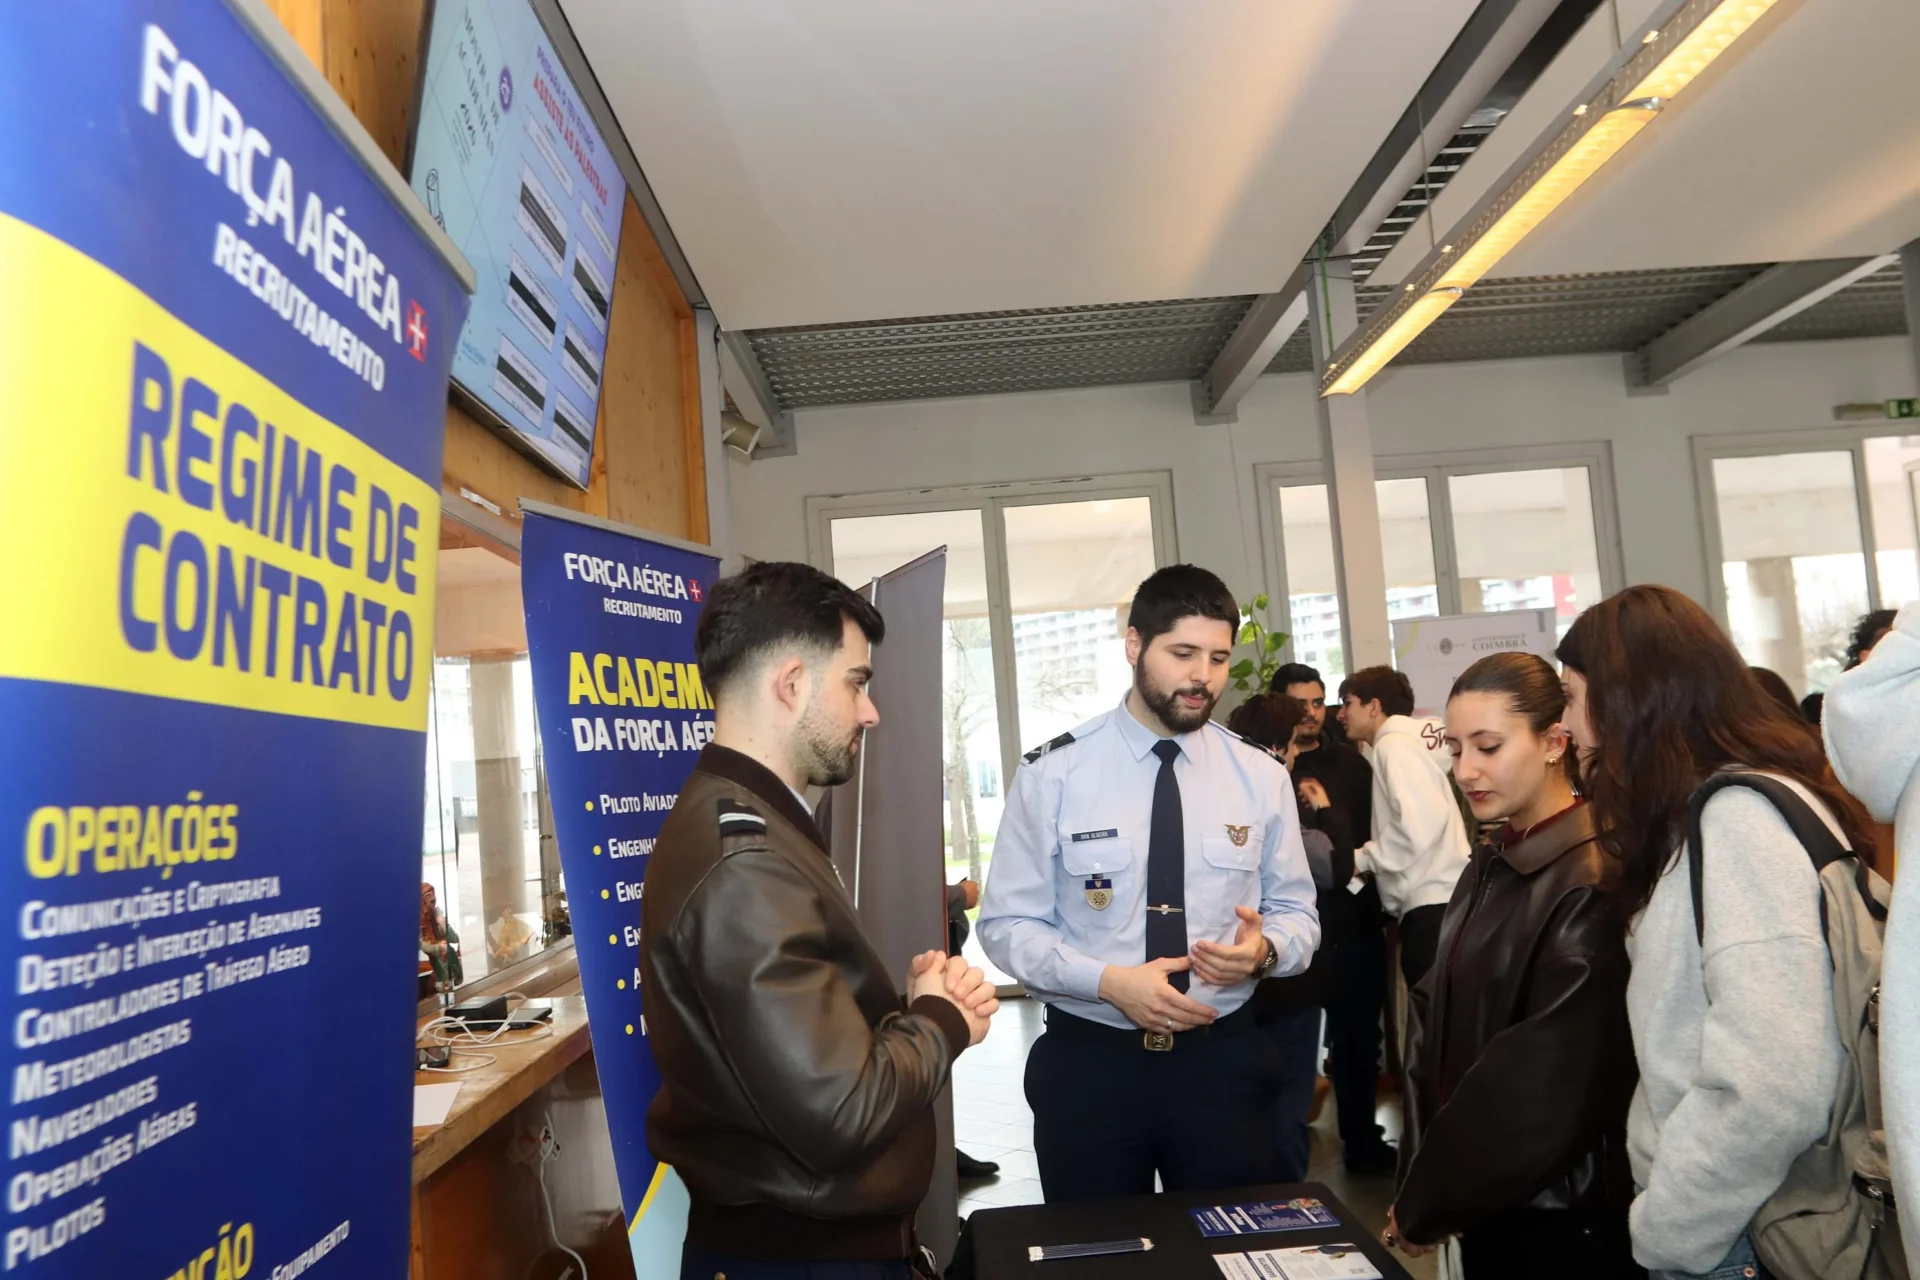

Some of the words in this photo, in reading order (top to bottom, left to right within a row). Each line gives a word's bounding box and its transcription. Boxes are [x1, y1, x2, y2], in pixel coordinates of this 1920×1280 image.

[140, 23, 295, 245] FORÇA
[297, 192, 403, 343] AÉREA
[214, 222, 385, 391] RECRUTAMENTO
[126, 339, 356, 570] REGIME
[366, 483, 419, 595] DE
[119, 511, 413, 702] CONTRATO
[563, 552, 631, 593] FORÇA
[633, 564, 689, 600] AÉREA
[603, 598, 682, 624] RECRUTAMENTO
[568, 652, 715, 710] ACADEM
[571, 717, 613, 752] DA
[614, 718, 678, 758] FORÇA
[25, 791, 238, 878] OPERAÇÕES
[600, 793, 641, 815] PILOTO
[608, 838, 657, 859] ENGENH
[18, 942, 121, 995] DETEÇÃO
[123, 943, 136, 972] E
[136, 920, 226, 969] INTERCEÇÃO
[228, 919, 246, 944] DE
[247, 907, 322, 940] AERONAVES
[21, 887, 171, 940] COMUNICAÇÕES
[174, 889, 186, 914] E
[187, 876, 281, 911] CRIPTOGRAFIA
[15, 977, 180, 1049] CONTROLADORES
[182, 971, 204, 1000] DE
[205, 955, 265, 993] TRÁFEGO
[266, 943, 310, 975] AÉREO
[12, 1018, 191, 1105] METEOROLOGISTAS
[8, 1133, 134, 1214] OPERAÇÕES
[136, 1101, 197, 1154] AÉREAS
[10, 1075, 158, 1160] NAVEGADORES
[5, 1196, 106, 1271] PILOTOS
